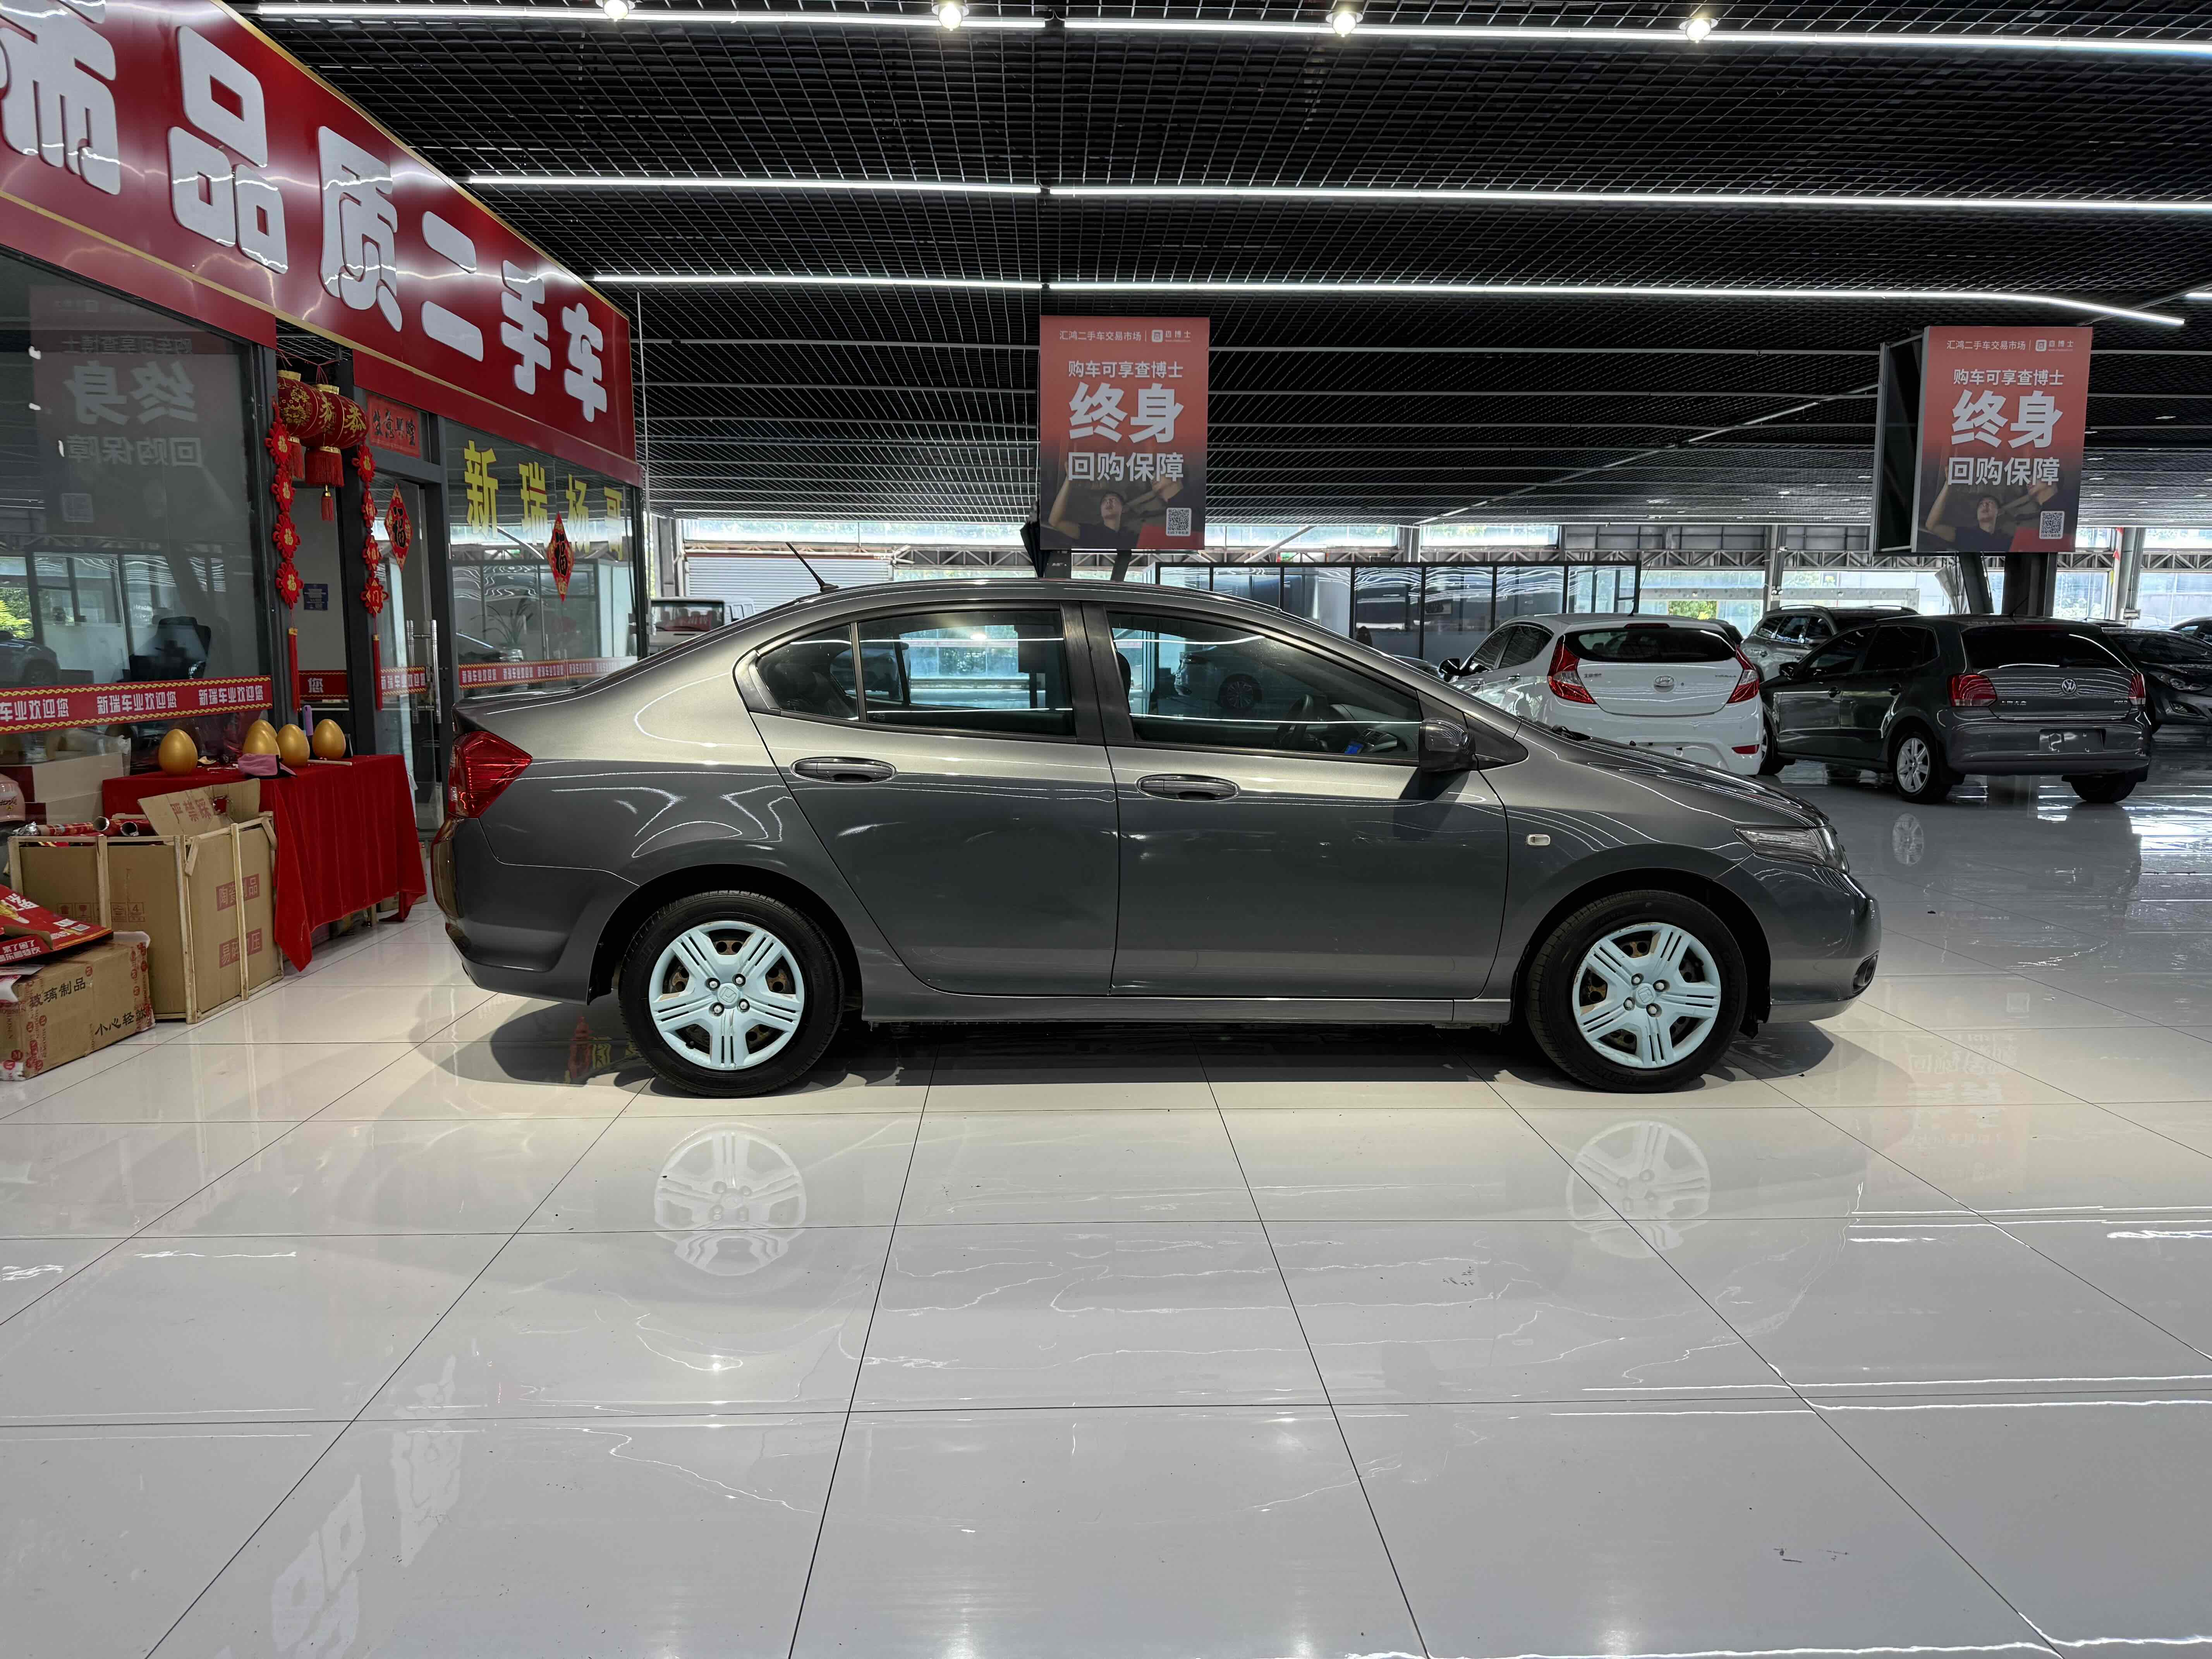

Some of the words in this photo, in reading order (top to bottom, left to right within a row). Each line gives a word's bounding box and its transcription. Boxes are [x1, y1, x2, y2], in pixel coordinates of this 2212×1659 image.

[1060, 330, 1141, 341] 汇鸿二手车交易市场
[1947, 340, 2026, 350] 汇鸿二手车交易市场
[1068, 361, 1183, 378] 购车可享查博士
[1953, 369, 2064, 386] 购车可享查博士
[1068, 382, 1184, 443] 终身
[1951, 390, 2063, 449] 终身
[1068, 452, 1184, 482] 回购保障
[1948, 456, 2060, 486] 回购保障
[393, 506, 406, 548] 福
[199, 685, 264, 706] 新瑞车业欢迎您
[308, 678, 324, 693] 您
[0, 698, 69, 721] 车业欢迎您
[97, 691, 177, 714] 新瑞车业欢迎您
[222, 932, 260, 965] 易碎压
[29, 976, 86, 1008] 玻璃制品
